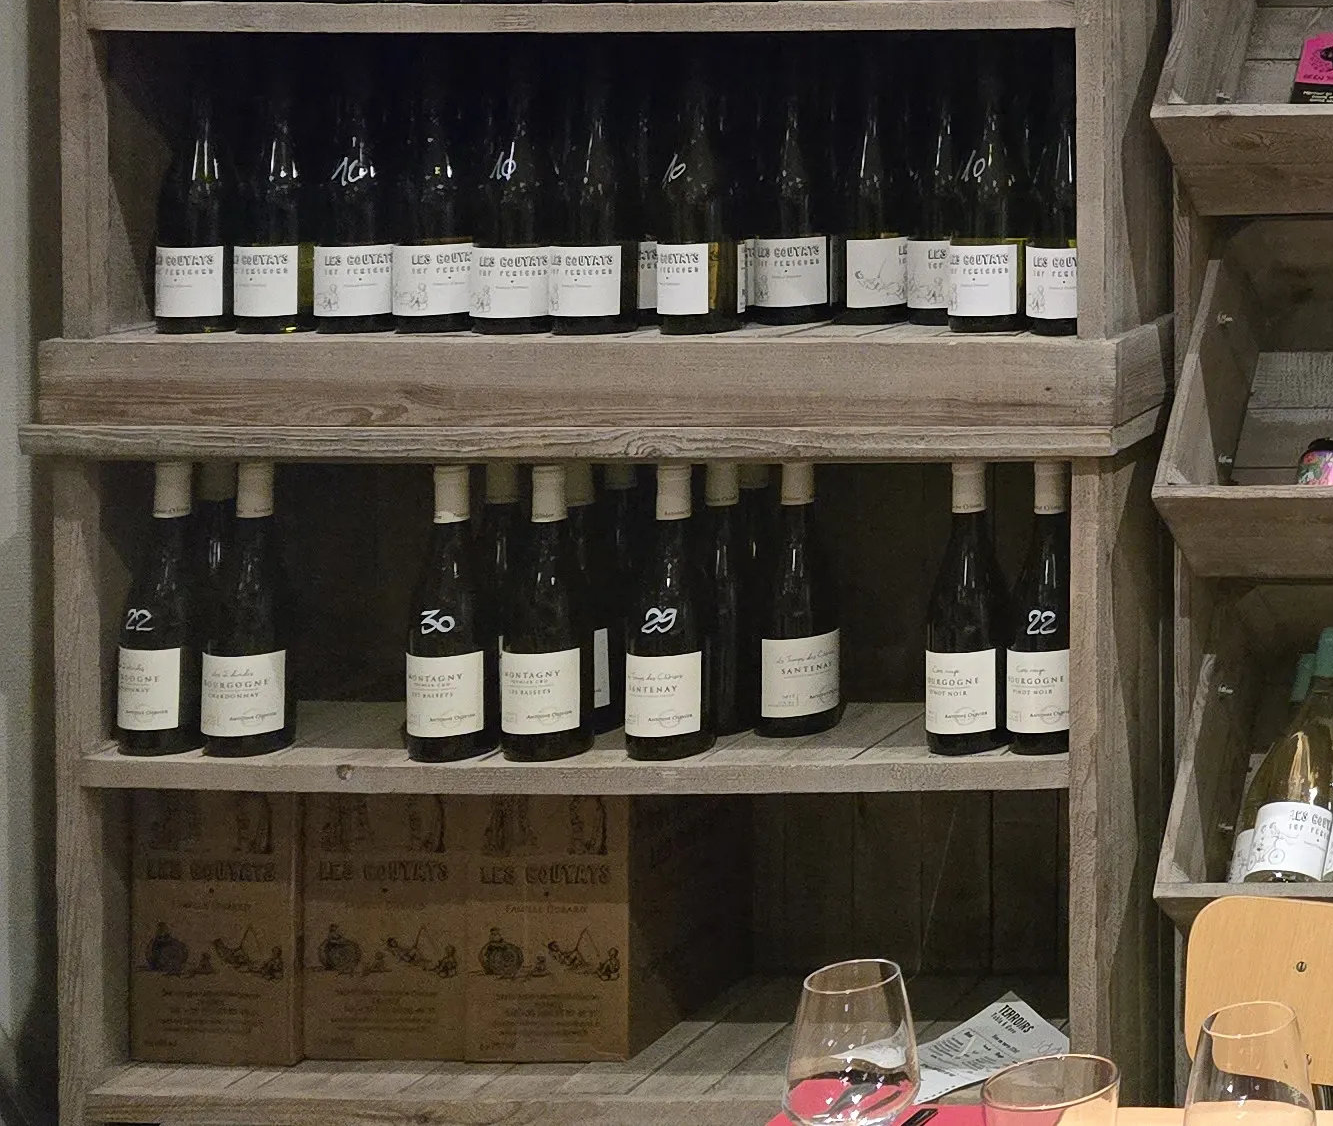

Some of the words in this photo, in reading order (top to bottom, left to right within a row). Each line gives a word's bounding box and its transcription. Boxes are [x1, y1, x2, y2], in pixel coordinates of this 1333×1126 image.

[662, 153, 686, 189] 10
[961, 150, 986, 182] 10
[411, 254, 431, 266] LES
[928, 248, 946, 260] LES
[125, 608, 154, 632] 22
[420, 609, 455, 635] 30
[641, 607, 677, 634] 29
[1027, 609, 1058, 635] 22
[998, 1005, 1034, 1034] TERROIRS
